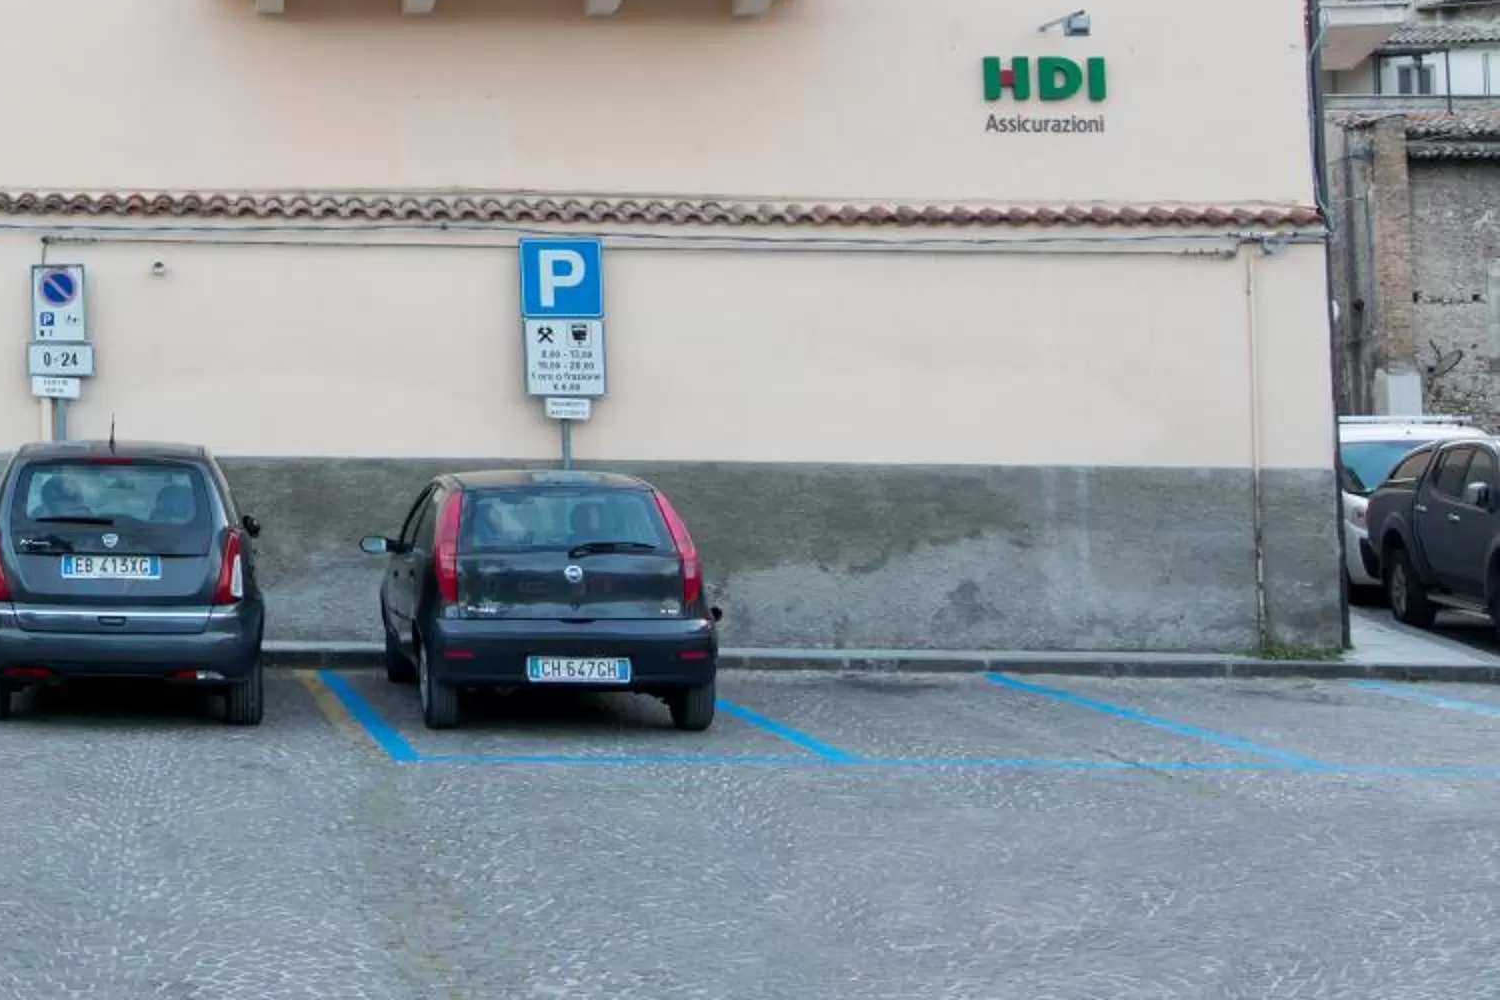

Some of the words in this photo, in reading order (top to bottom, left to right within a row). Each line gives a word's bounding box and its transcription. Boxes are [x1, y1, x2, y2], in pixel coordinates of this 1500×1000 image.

[982, 56, 1107, 102] HDI
[985, 113, 1105, 133] Assicurazioni
[538, 249, 586, 308] P
[75, 556, 94, 573] EB
[541, 660, 561, 676] CH
